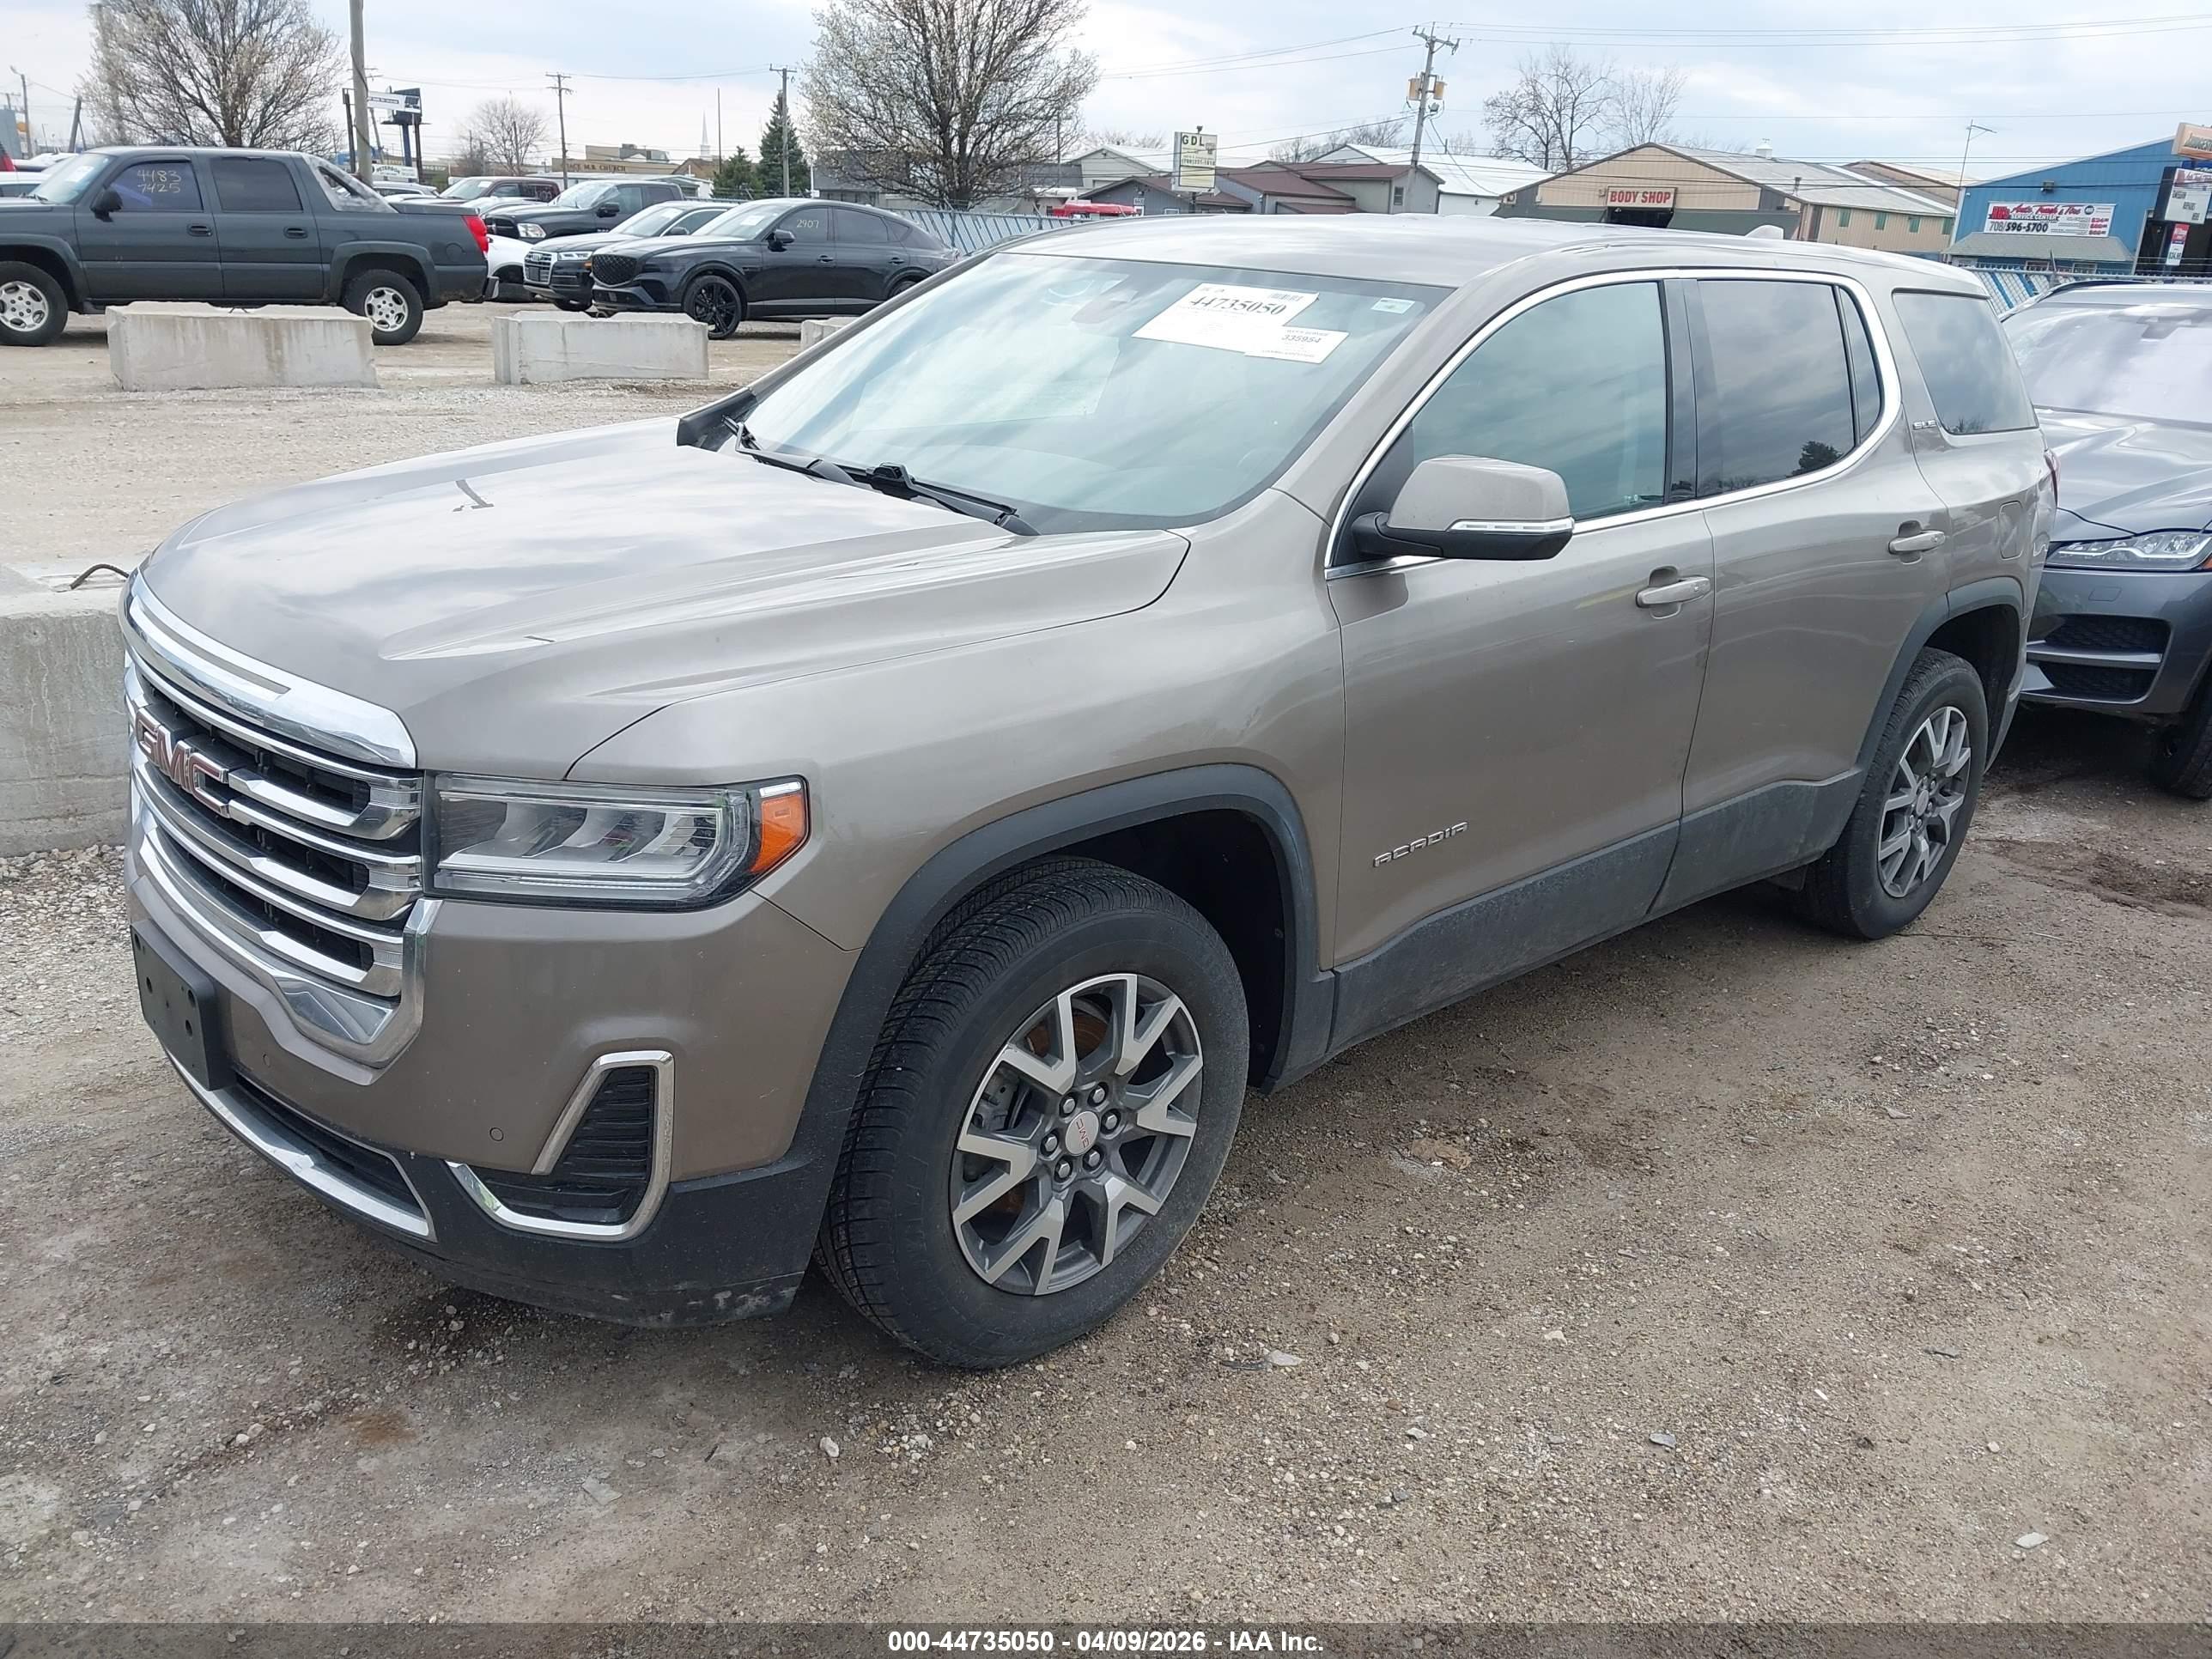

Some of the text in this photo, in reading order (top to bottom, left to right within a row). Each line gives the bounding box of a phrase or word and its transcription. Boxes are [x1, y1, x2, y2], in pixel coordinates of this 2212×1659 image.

[1182, 134, 1205, 147] GDL
[599, 164, 626, 173] CHURCH
[1609, 191, 1672, 204] BODY SHOP
[797, 220, 819, 228] 2907
[1189, 295, 1287, 315] 44735050
[1281, 334, 1322, 343] 335954
[136, 708, 230, 818] GMC
[1374, 822, 1469, 867] ACADIA
[1075, 1117, 1091, 1150] GMC
